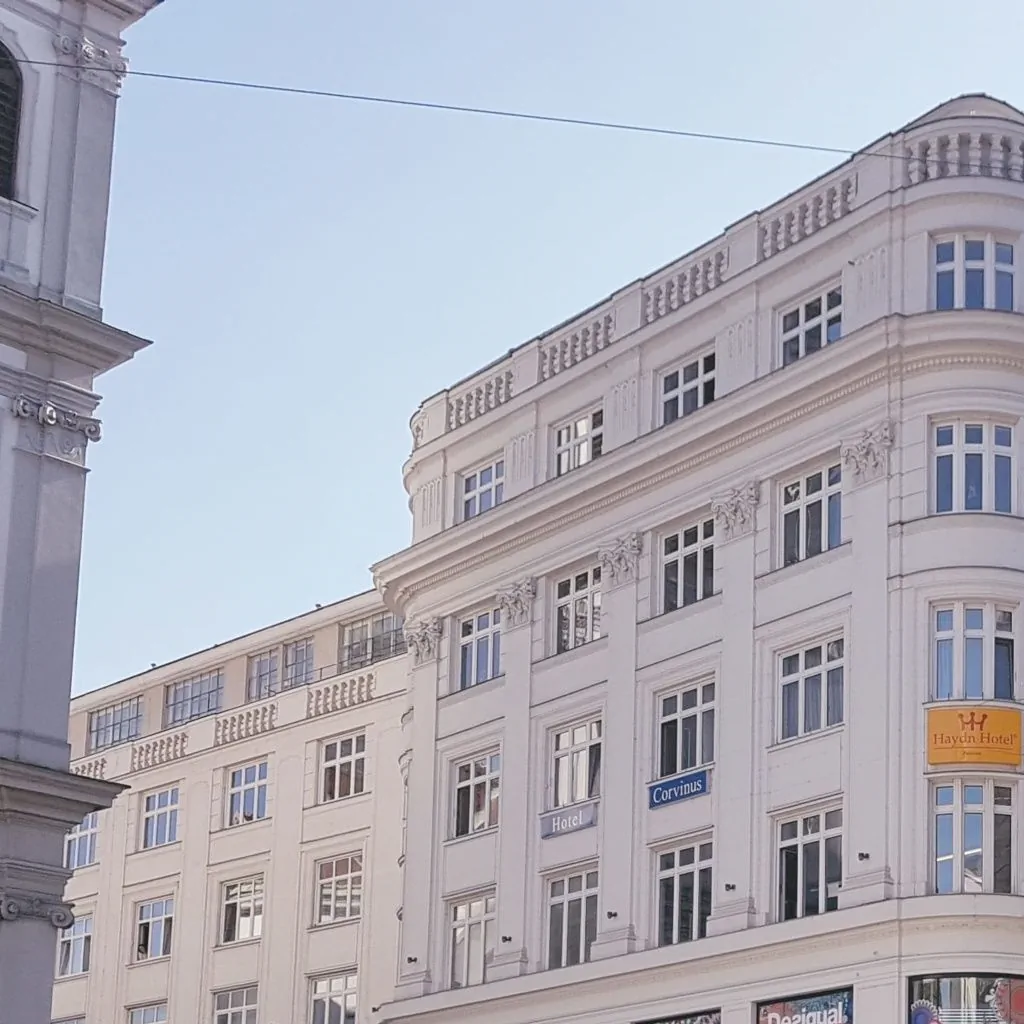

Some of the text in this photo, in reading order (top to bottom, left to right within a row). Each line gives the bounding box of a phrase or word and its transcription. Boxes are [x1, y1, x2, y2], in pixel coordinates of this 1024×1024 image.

[933, 731, 976, 748] Haydn
[652, 779, 703, 803] Corvinus
[552, 810, 584, 833] Hotel
